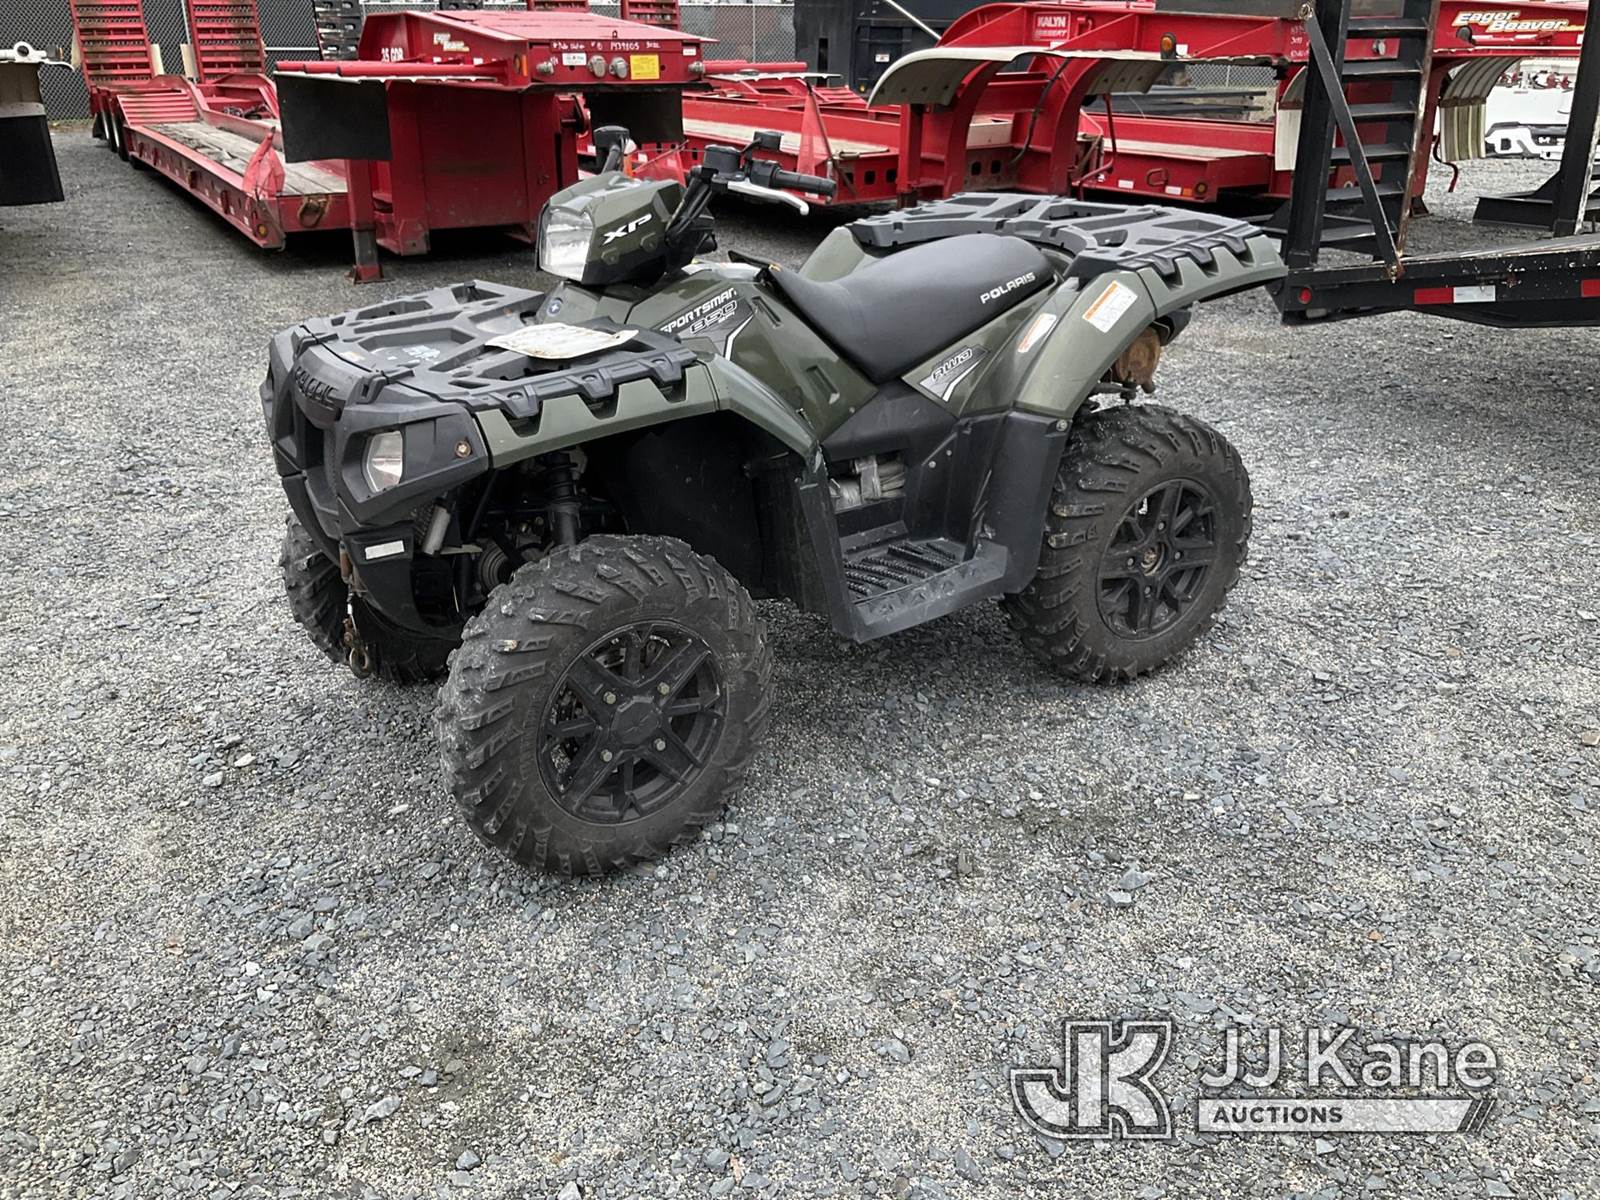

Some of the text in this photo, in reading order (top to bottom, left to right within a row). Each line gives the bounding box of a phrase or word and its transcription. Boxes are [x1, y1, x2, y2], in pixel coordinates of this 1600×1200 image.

[1037, 16, 1066, 28] KALYN
[1452, 10, 1520, 26] Eager
[1486, 19, 1569, 32] Beaver
[602, 213, 653, 246] XP
[980, 272, 1036, 305] POLARIS
[659, 287, 738, 333] SPORTSMAN
[689, 300, 738, 334] 850
[931, 348, 973, 382] AWD
